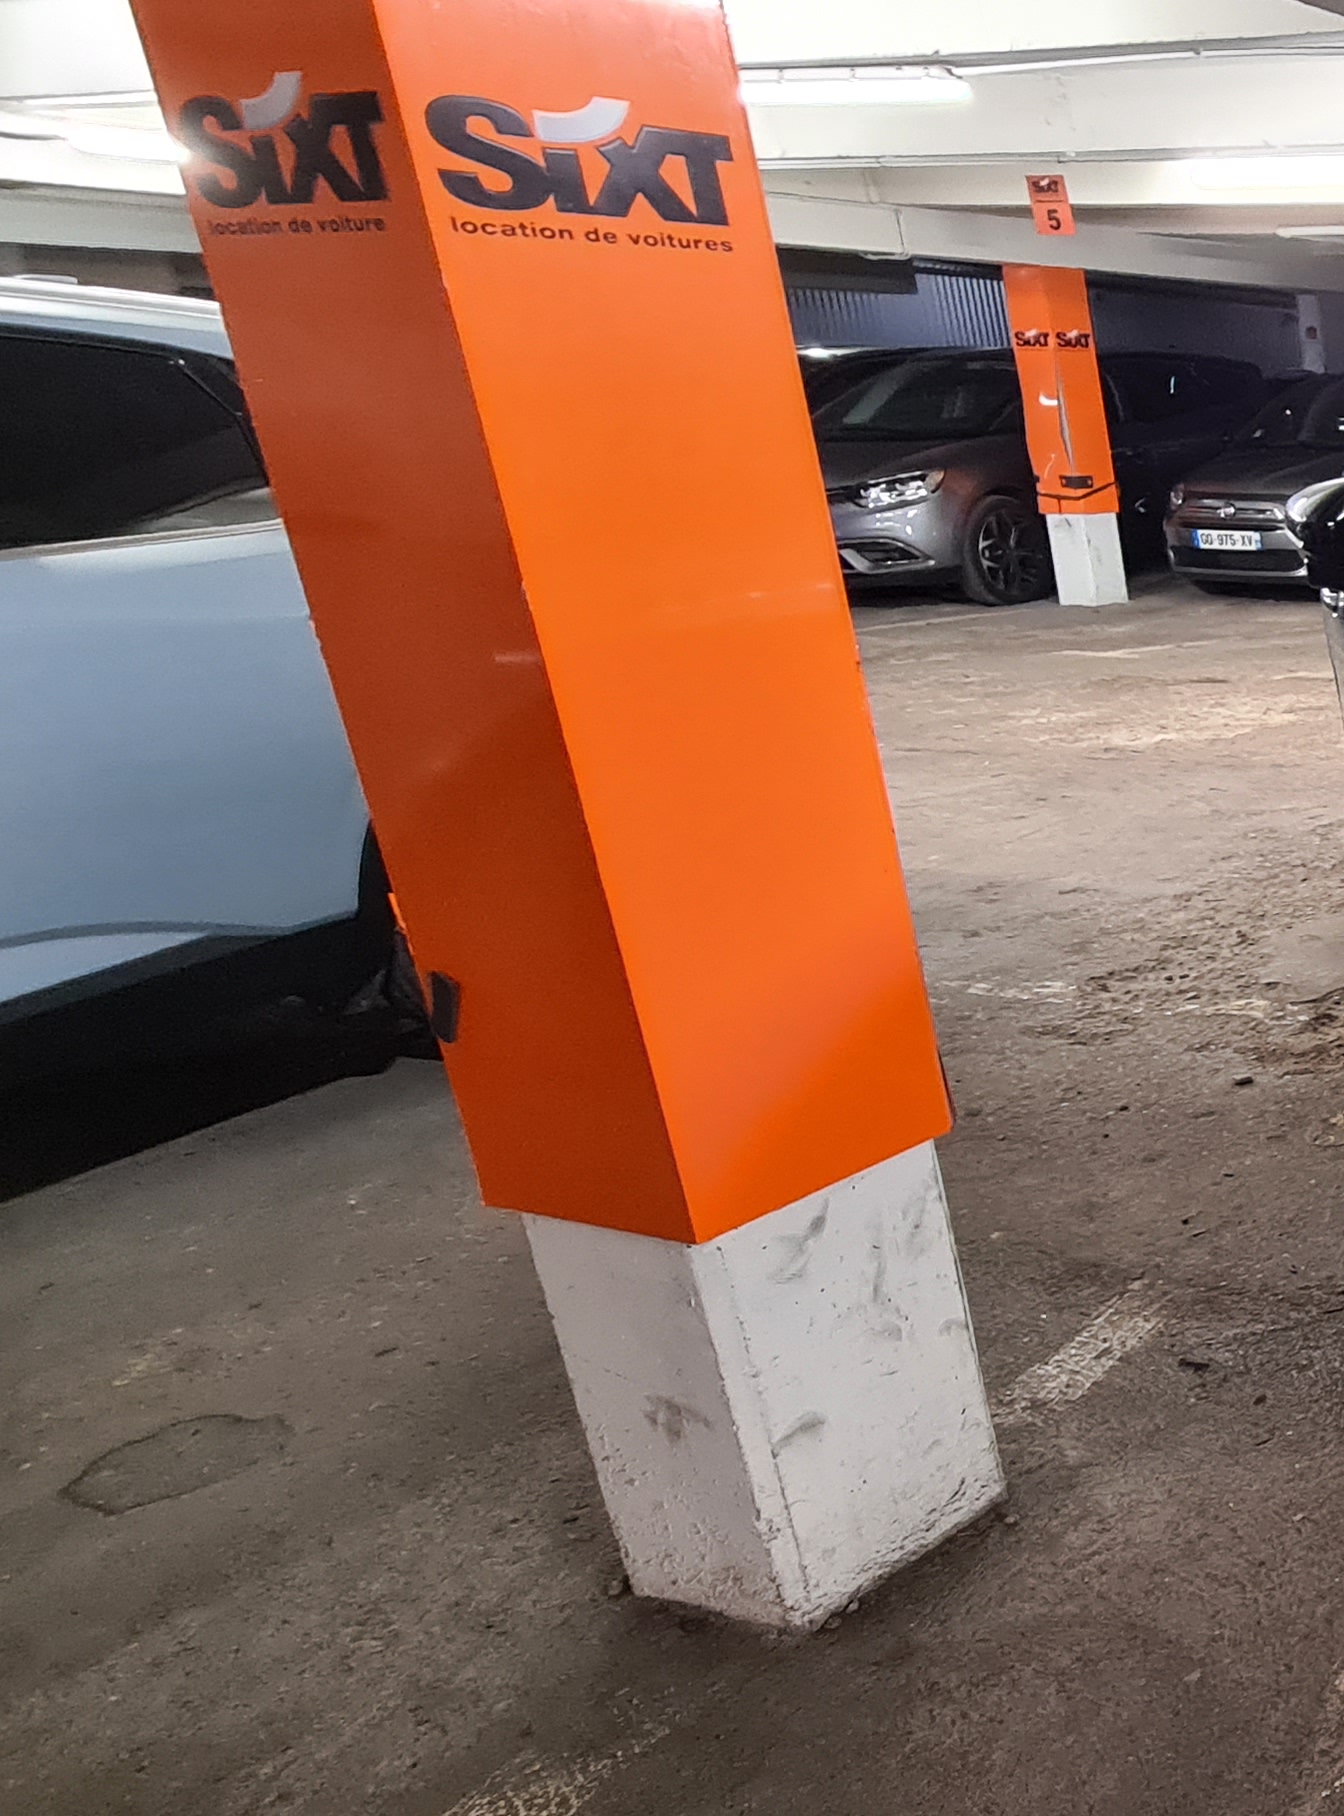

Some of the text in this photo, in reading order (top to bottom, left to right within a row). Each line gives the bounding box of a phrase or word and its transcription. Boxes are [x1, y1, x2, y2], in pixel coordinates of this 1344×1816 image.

[208, 218, 282, 235] location
[289, 218, 312, 233] de
[1046, 208, 1062, 231] 5
[449, 216, 734, 252] location de voitures
